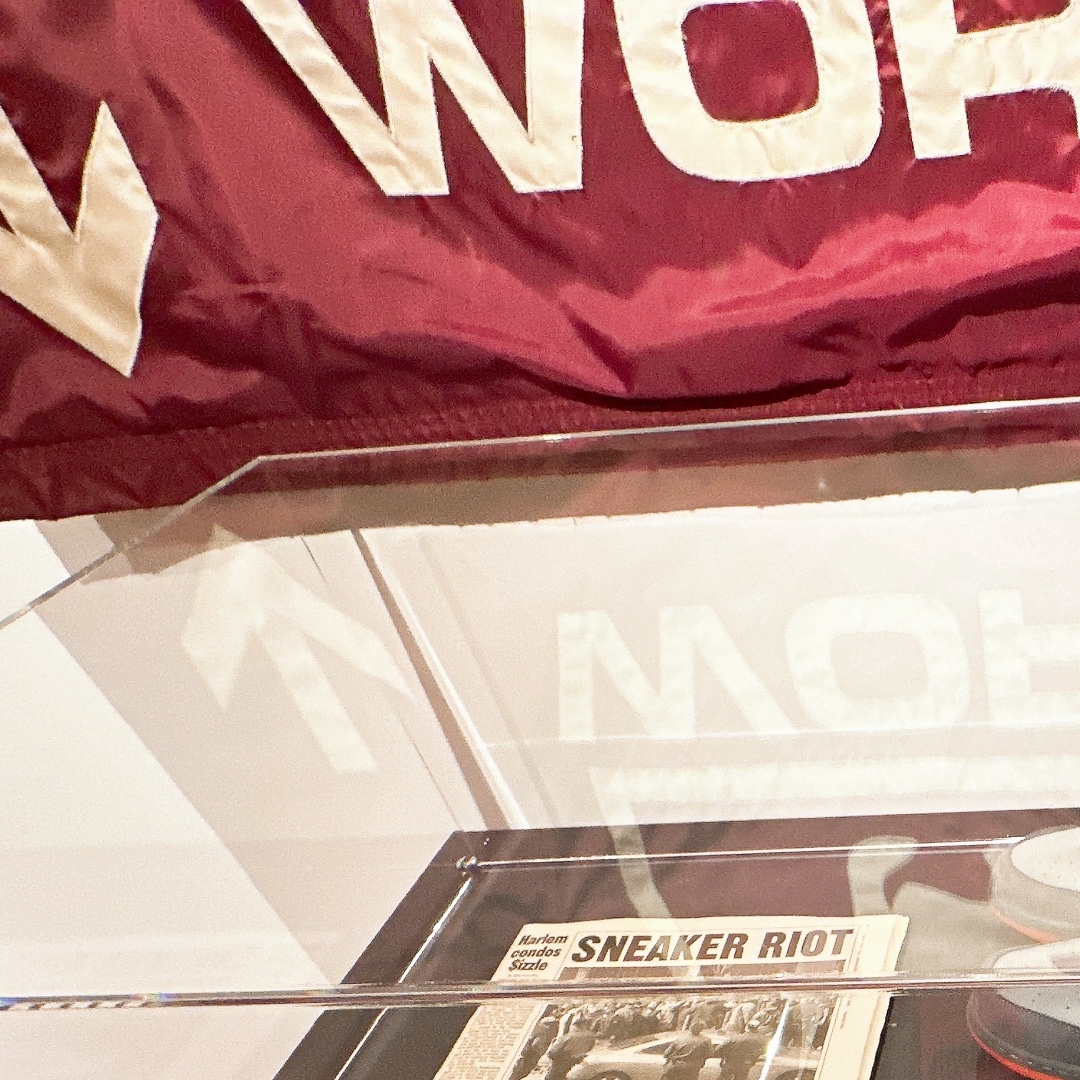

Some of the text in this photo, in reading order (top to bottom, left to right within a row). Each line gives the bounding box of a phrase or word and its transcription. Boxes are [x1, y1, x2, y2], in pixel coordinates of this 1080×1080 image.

[518, 934, 568, 945] Harlem
[510, 946, 561, 958] condos
[572, 929, 854, 963] SNEAKER RIOT
